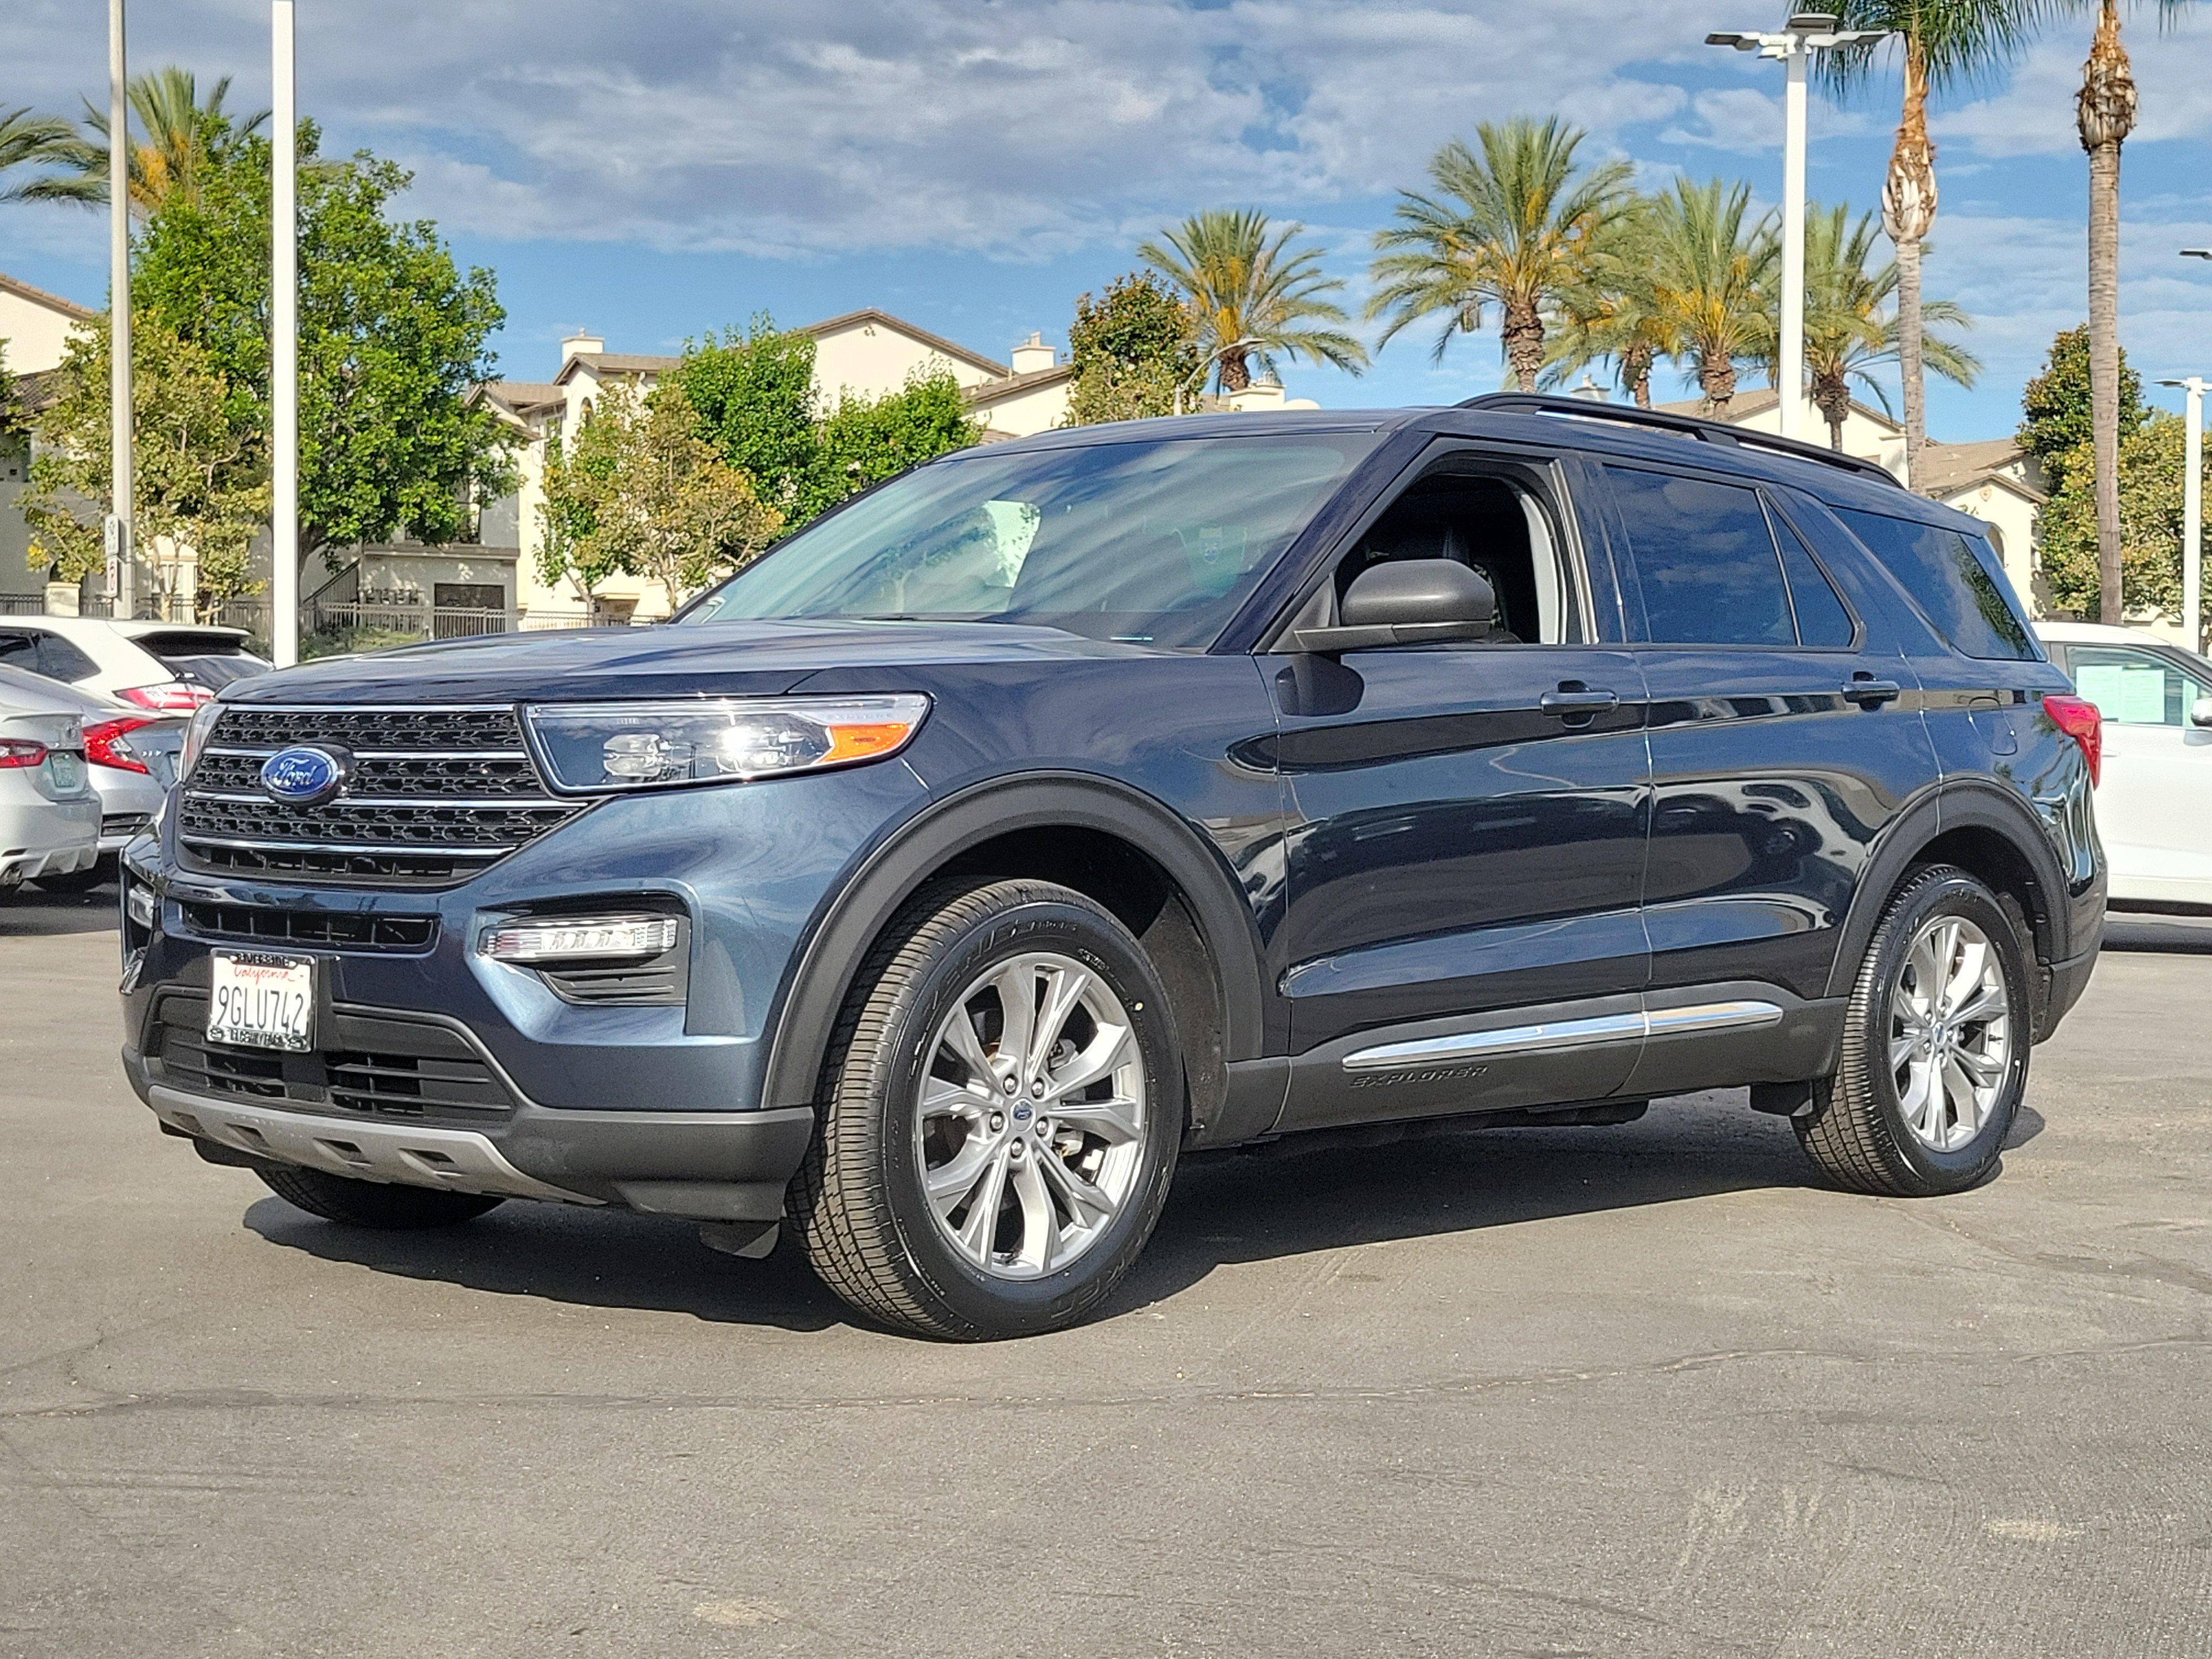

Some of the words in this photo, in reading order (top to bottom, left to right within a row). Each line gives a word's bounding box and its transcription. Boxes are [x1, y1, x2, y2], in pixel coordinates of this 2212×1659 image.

[274, 757, 317, 787] Ford
[234, 964, 296, 985] California
[217, 985, 304, 1035] 9GLU742
[1350, 1065, 1488, 1088] EXPLORER
